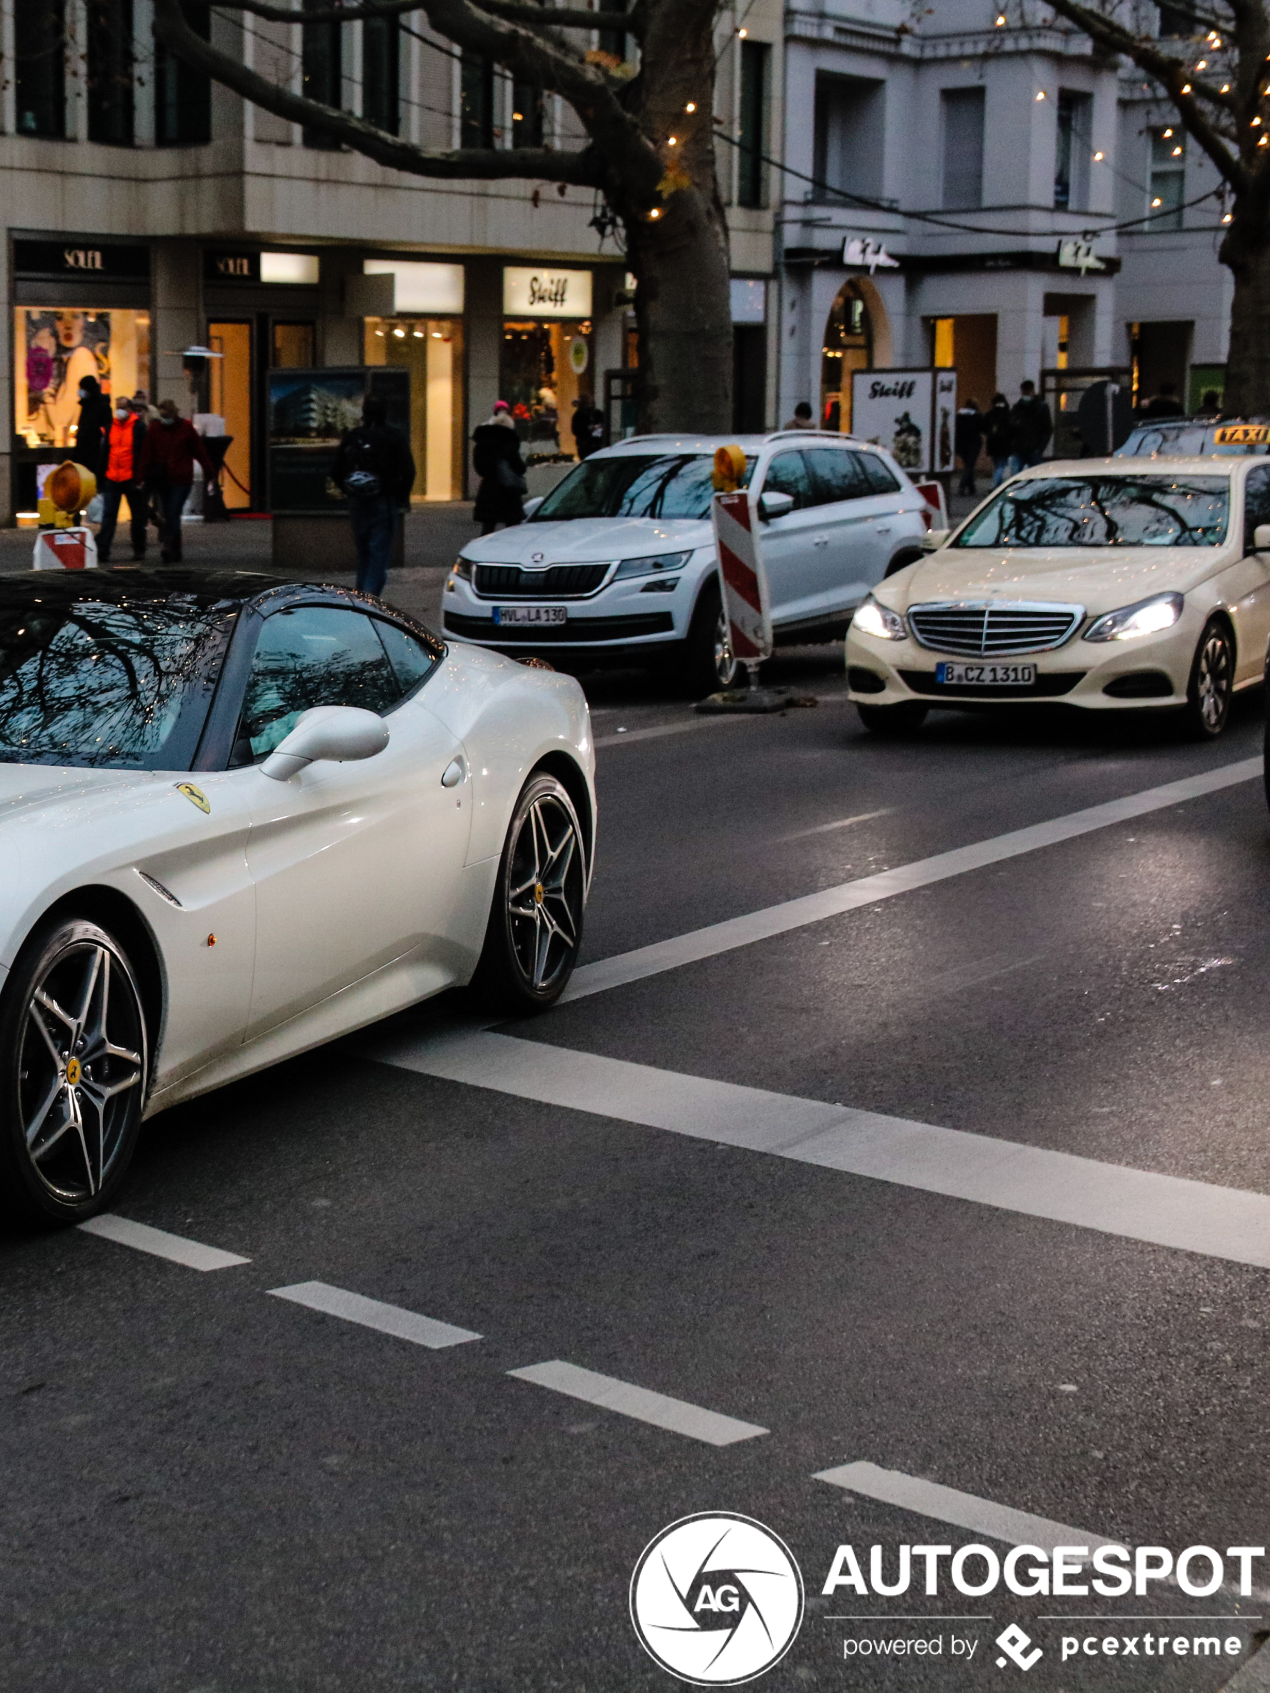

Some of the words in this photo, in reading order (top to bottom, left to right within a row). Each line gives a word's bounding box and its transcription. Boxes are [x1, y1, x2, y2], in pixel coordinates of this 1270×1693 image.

[529, 276, 568, 308] Steiff
[1222, 428, 1268, 441] TAXI
[500, 609, 521, 622] HVL
[527, 609, 541, 622] LA
[544, 609, 564, 622] 130
[946, 666, 954, 682] B
[965, 667, 985, 682] CZ
[989, 667, 1031, 682] 1310
